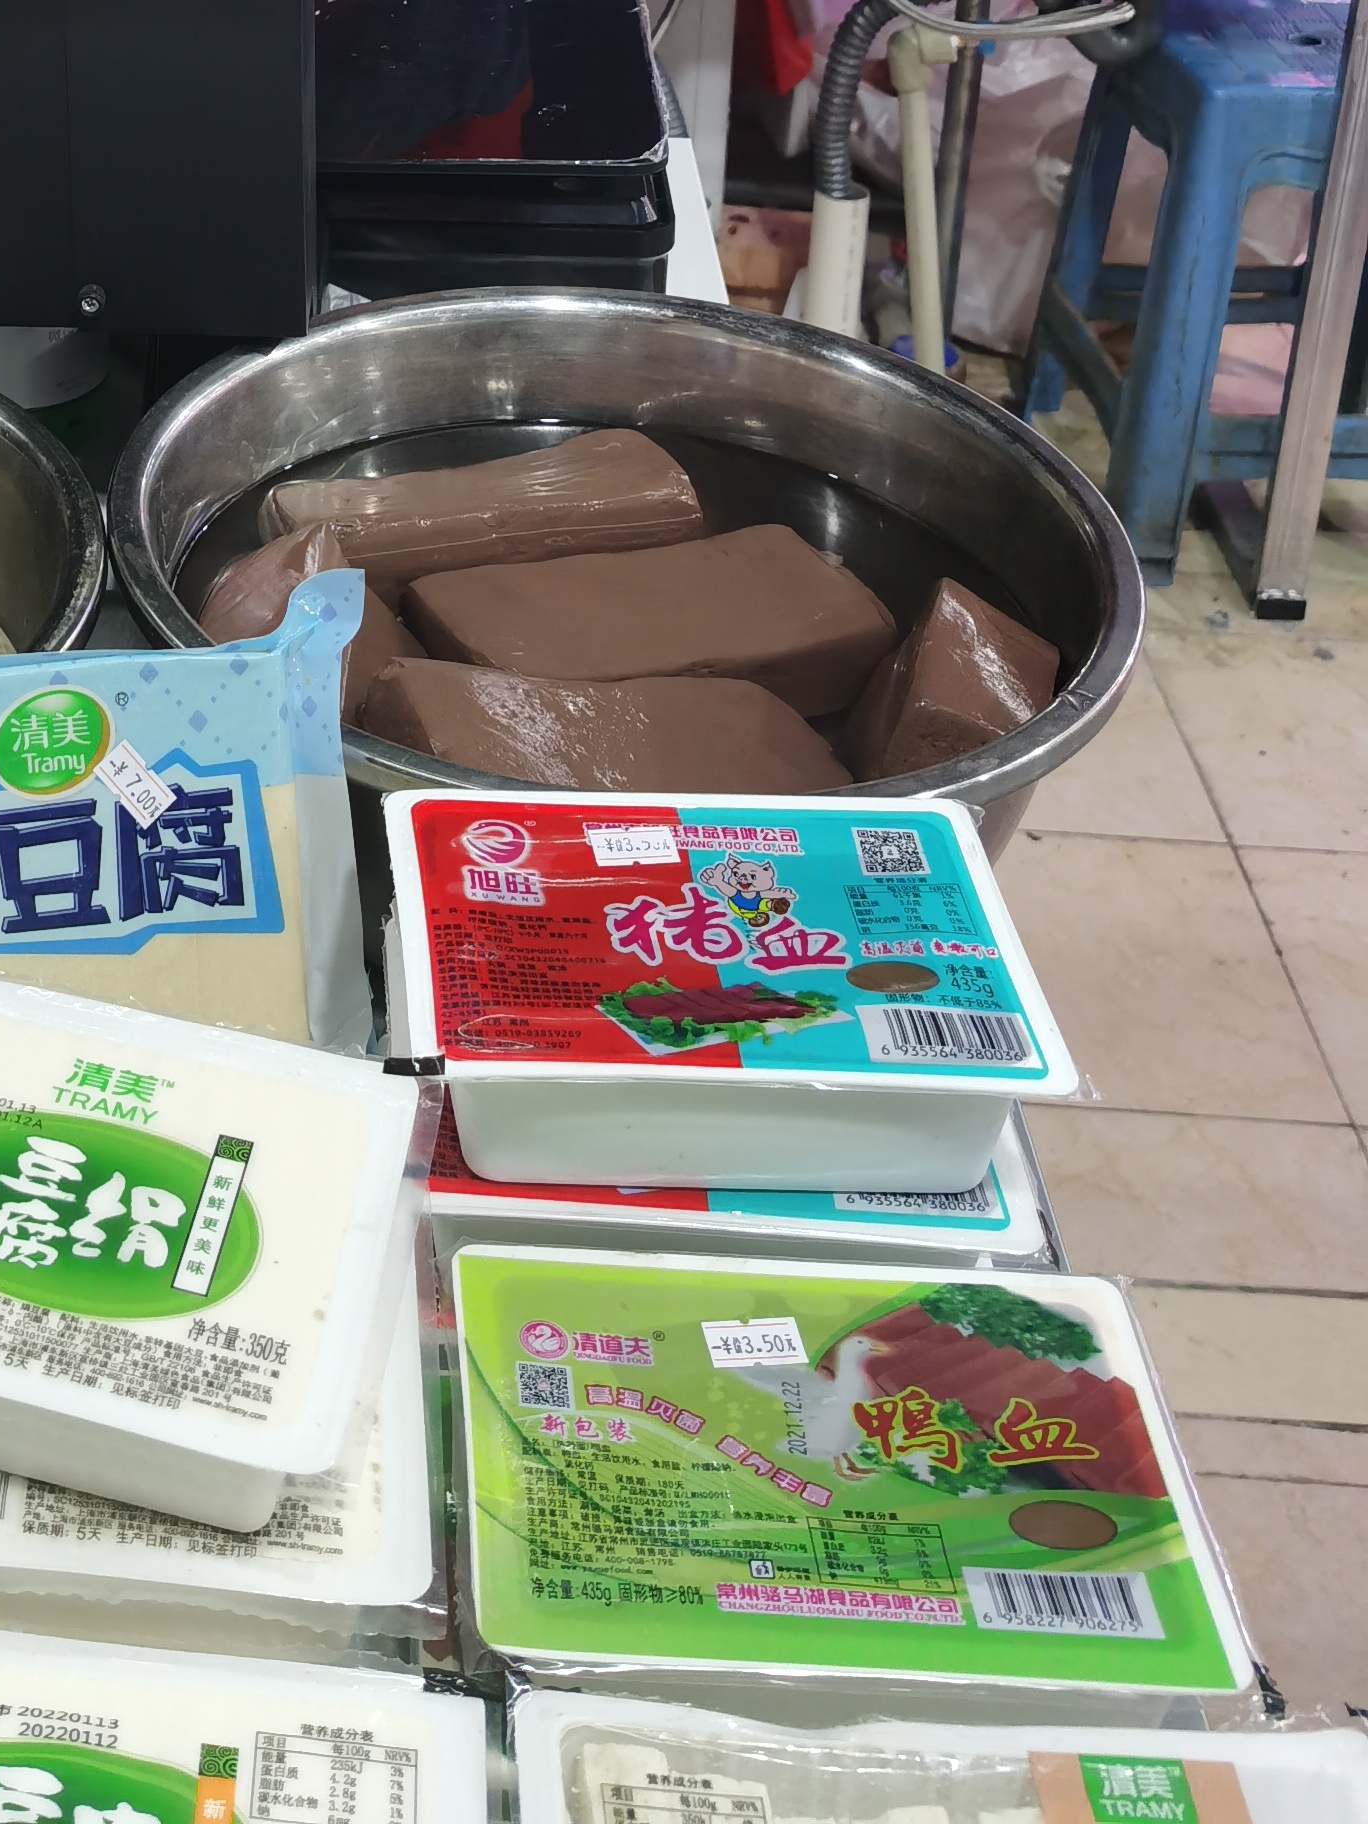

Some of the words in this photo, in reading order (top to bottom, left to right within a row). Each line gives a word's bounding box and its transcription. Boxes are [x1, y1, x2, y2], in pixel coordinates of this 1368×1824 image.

[9, 707, 93, 751] 清美
[21, 751, 87, 776] Tramy
[468, 867, 539, 896] 旭旺
[605, 886, 848, 972] 猪血
[951, 977, 995, 998] 435g
[900, 1043, 959, 1059] 935564
[965, 1047, 1024, 1062] 380036
[65, 1057, 161, 1104] 清美
[51, 1084, 161, 1126] TRAMY
[865, 1193, 923, 1210] 935564
[928, 1196, 986, 1213] 380036
[185, 1173, 236, 1277] 新鲜更美味
[571, 1331, 652, 1358] 清道夫
[539, 1412, 634, 1443] 新包装
[781, 1380, 809, 1456] 2021.12.22
[852, 1385, 1100, 1474] 鸭血
[715, 1582, 960, 1614] 常州骆马湖食品有限公司
[982, 1611, 993, 1624] 6
[1003, 1611, 1065, 1629] 958227
[16, 1705, 121, 1731] 20220113
[17, 1721, 120, 1750] 20220112
[262, 1735, 288, 1748] 项目
[300, 1723, 375, 1743] 营养成分表
[260, 1764, 300, 1780] 蛋白质
[1096, 1763, 1175, 1800] 清美
[202, 1797, 227, 1821] 新
[1099, 1797, 1186, 1822] TRAMY
